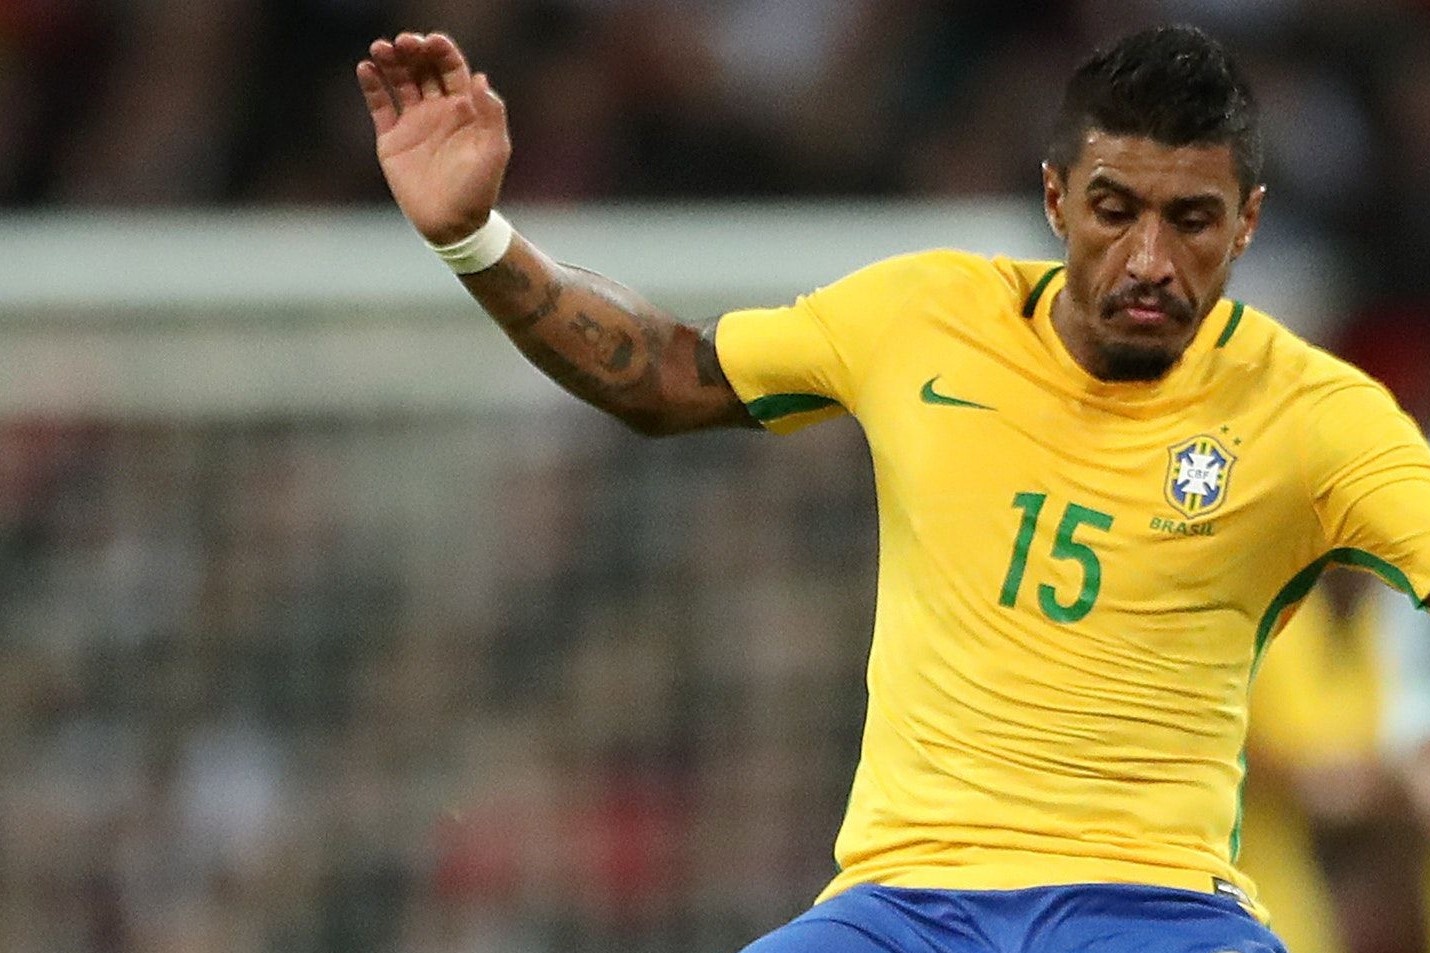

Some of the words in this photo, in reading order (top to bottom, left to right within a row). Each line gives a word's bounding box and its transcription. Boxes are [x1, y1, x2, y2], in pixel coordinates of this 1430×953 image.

[1186, 468, 1210, 480] CBF
[1149, 517, 1214, 537] BRASIL
[998, 493, 1114, 623] 15
